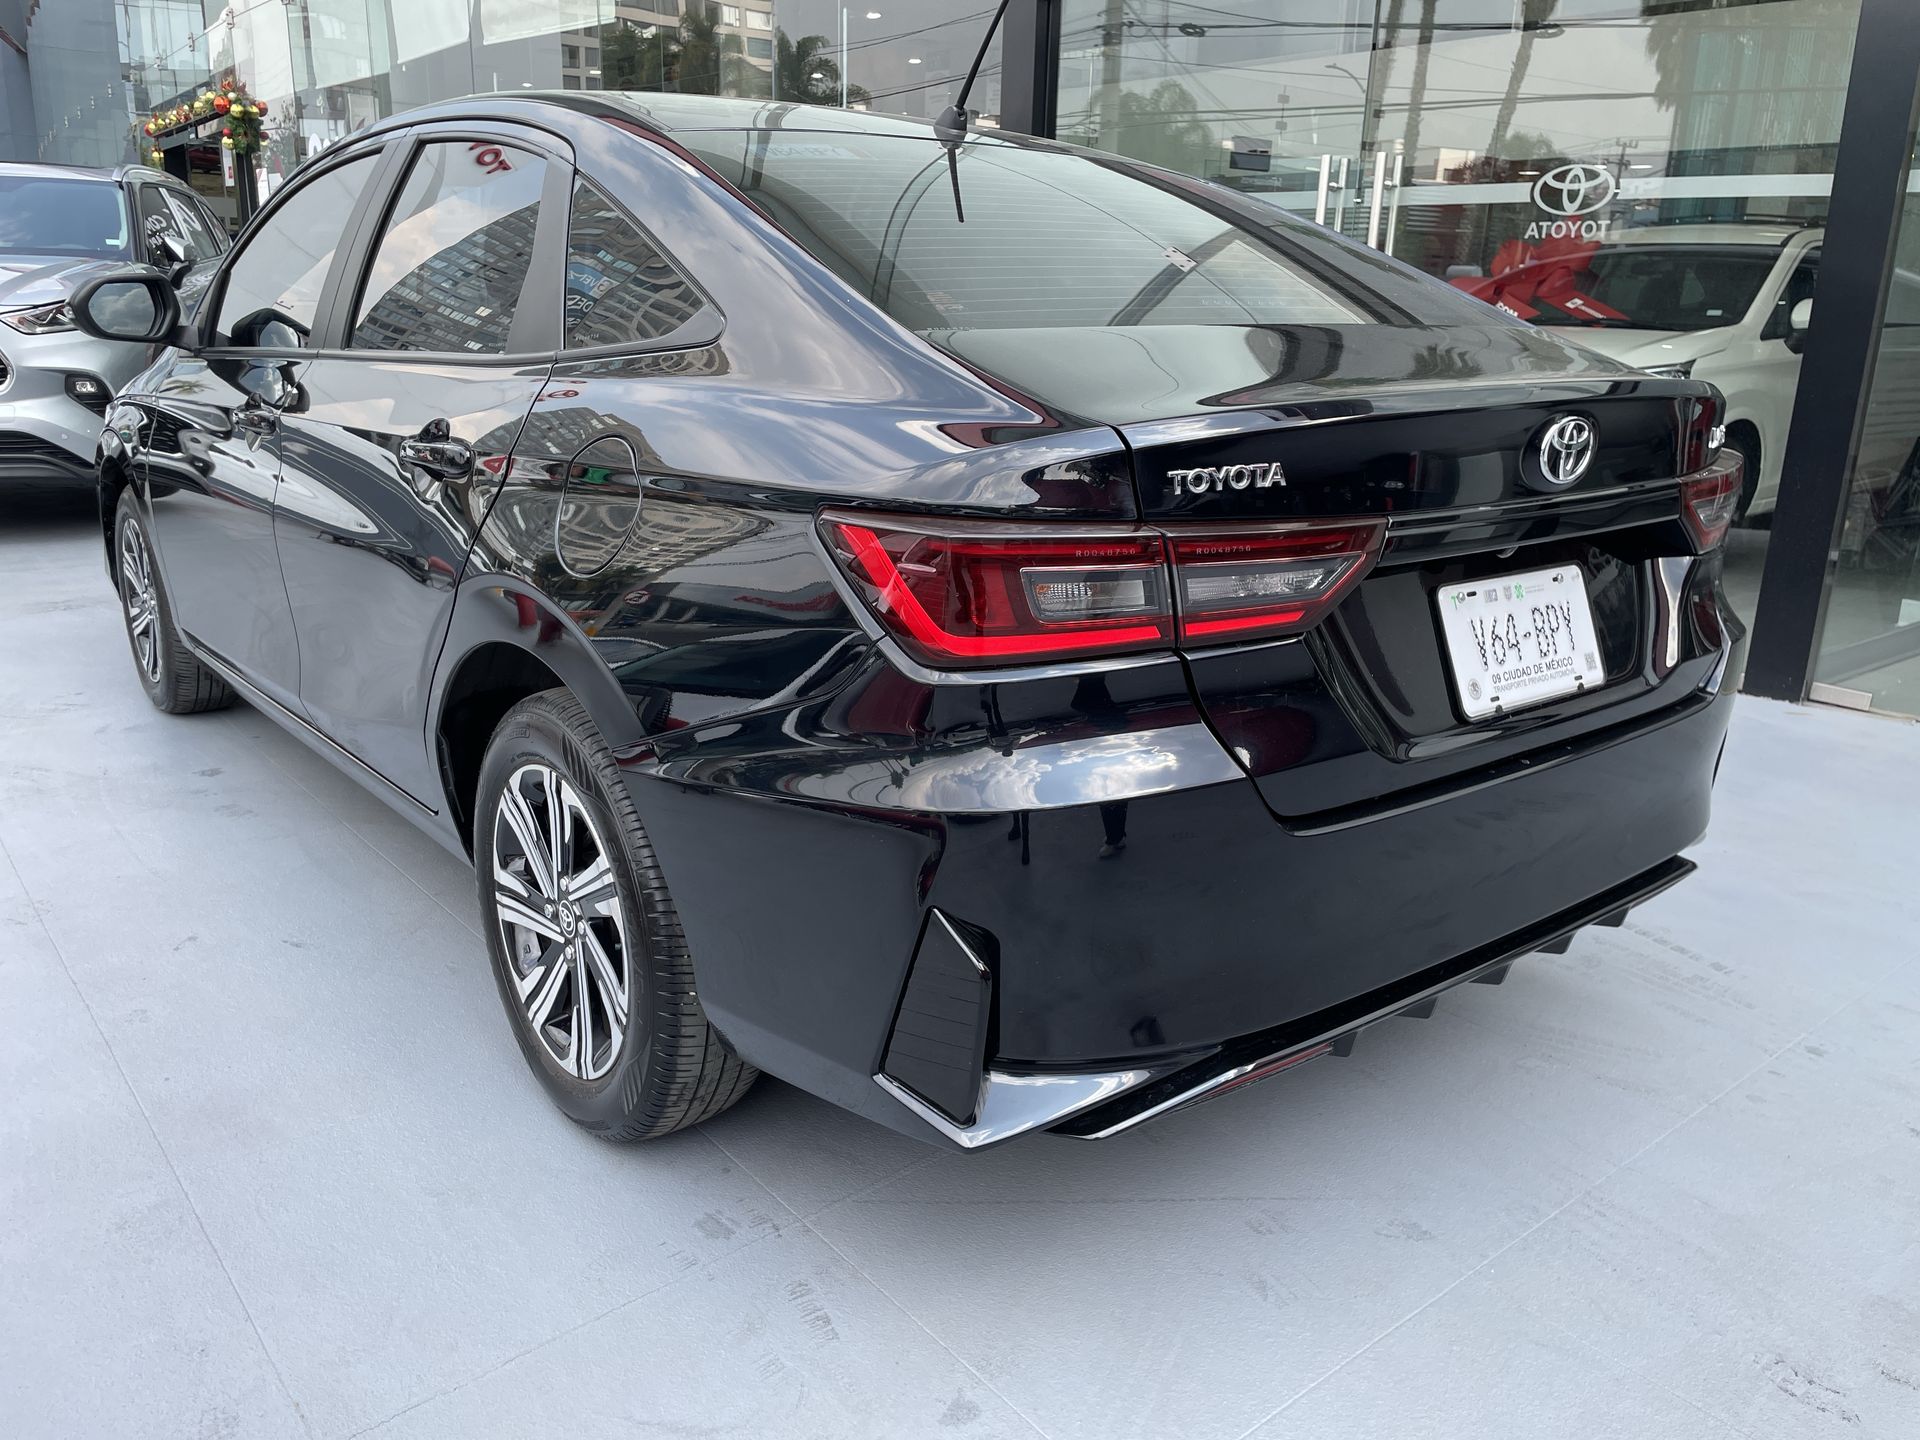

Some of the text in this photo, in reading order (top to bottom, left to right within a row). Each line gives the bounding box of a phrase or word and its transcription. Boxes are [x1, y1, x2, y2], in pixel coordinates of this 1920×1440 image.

[1167, 462, 1287, 495] TOYOTA
[1469, 601, 1576, 671] V64-BPY
[1491, 656, 1574, 685] 09 CIUDAD DE MÉXICO
[1493, 679, 1527, 693] TRANSPORTE
[1527, 673, 1550, 686] PRIVADO
